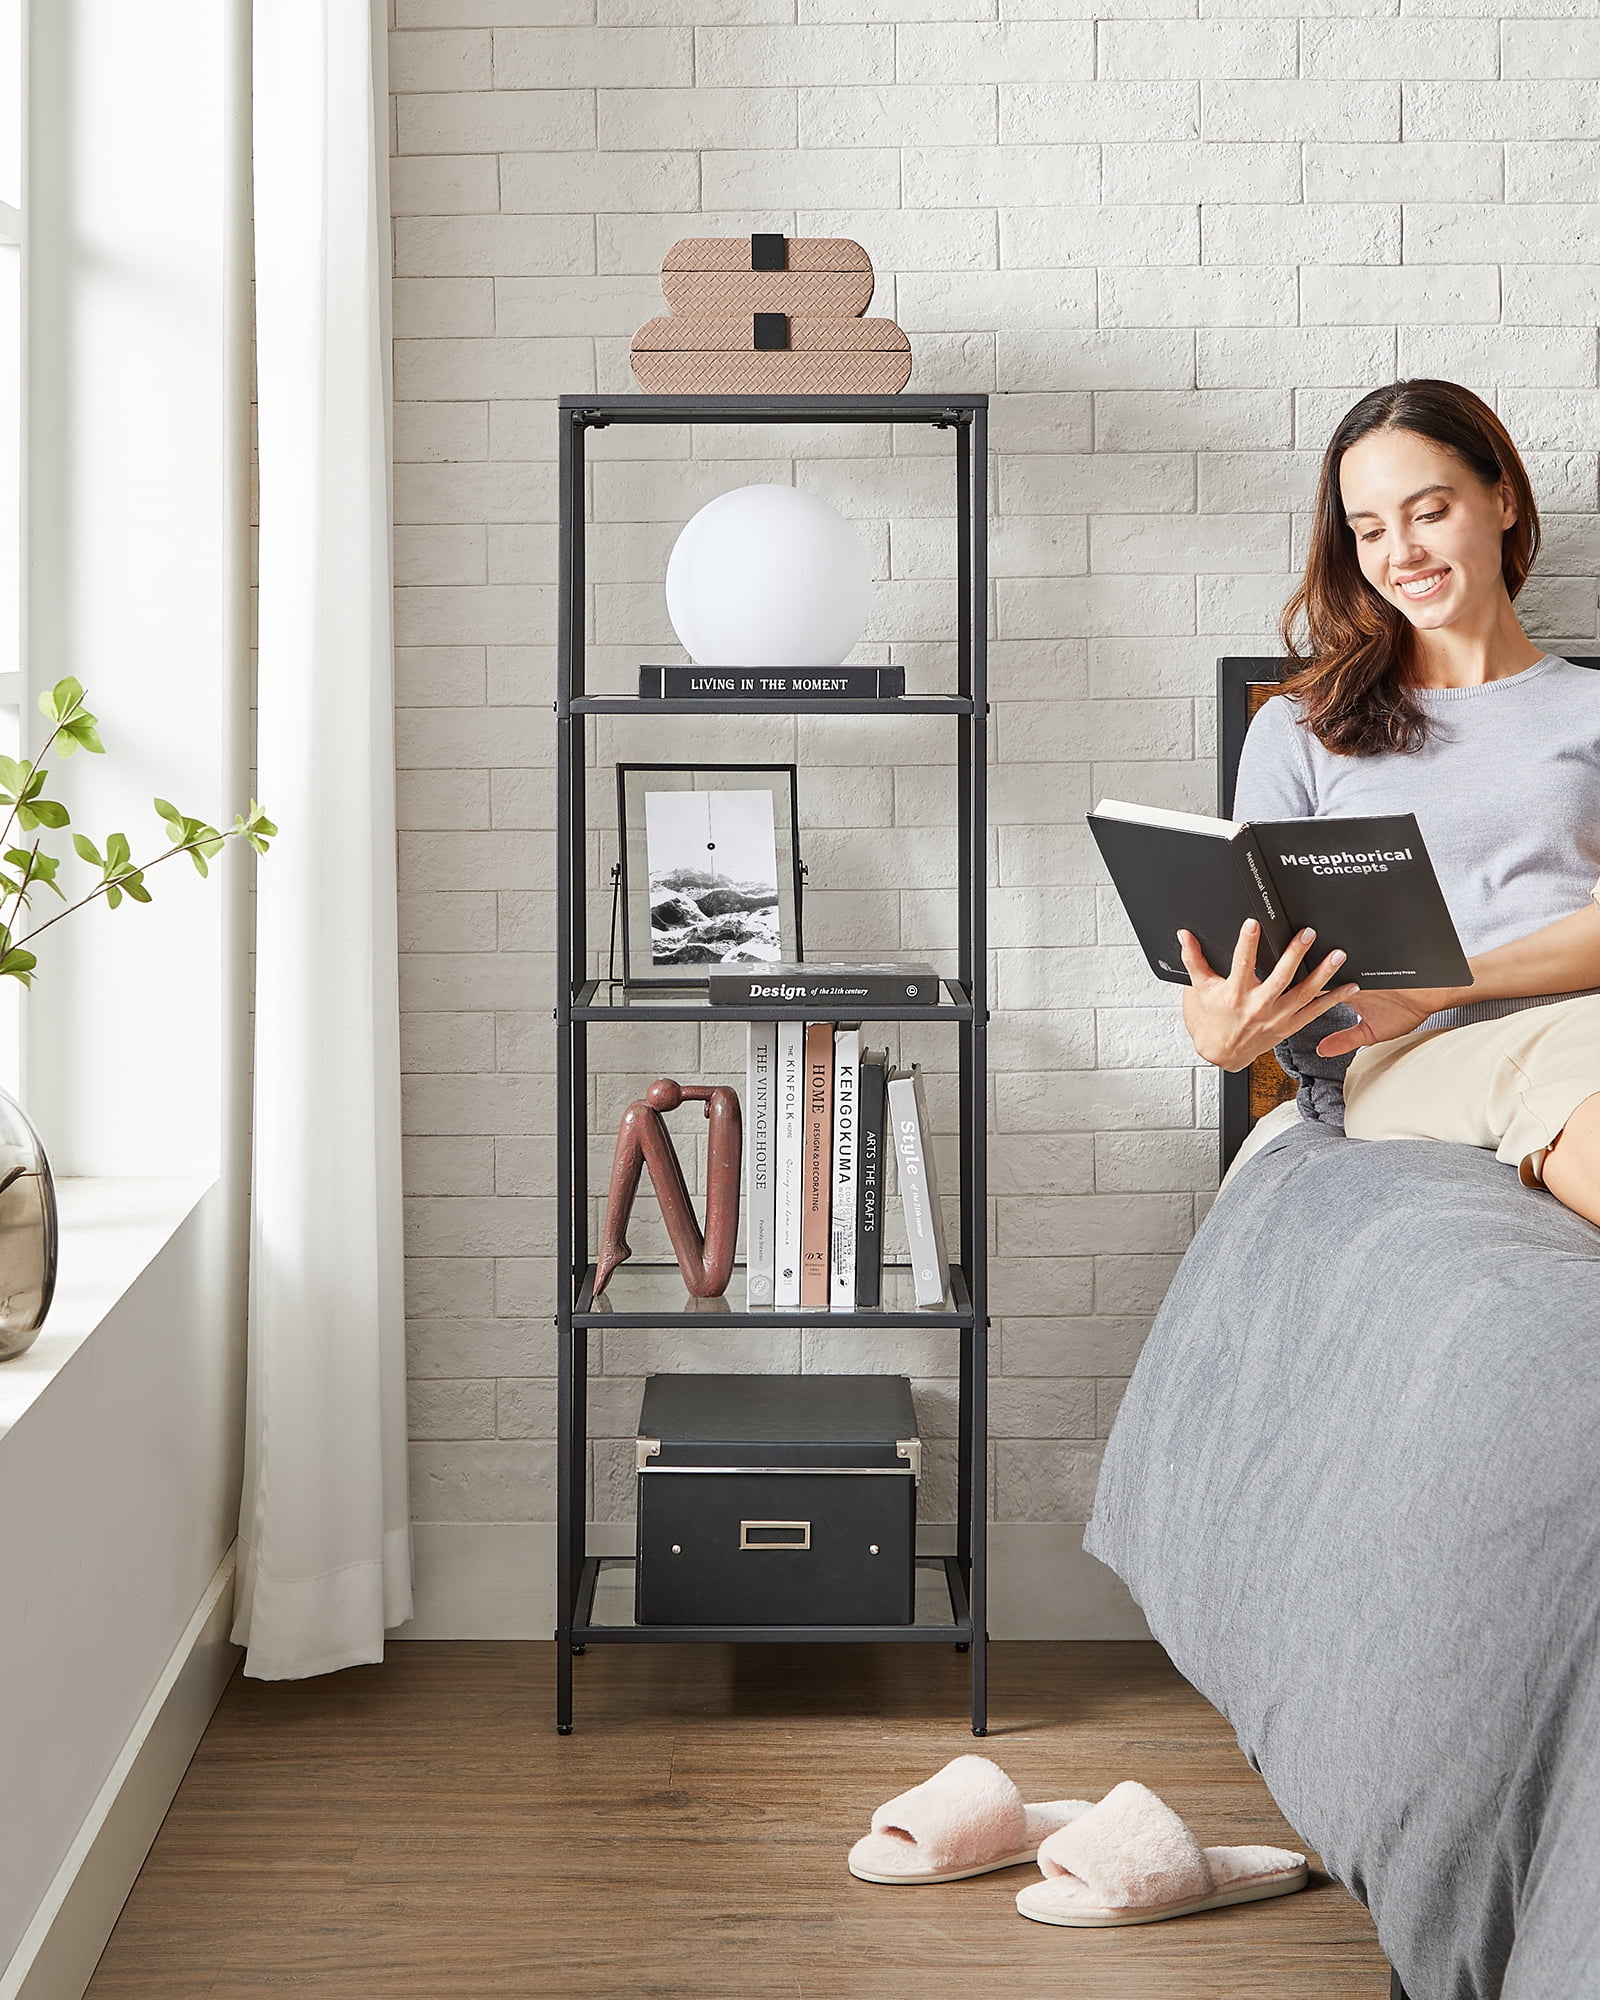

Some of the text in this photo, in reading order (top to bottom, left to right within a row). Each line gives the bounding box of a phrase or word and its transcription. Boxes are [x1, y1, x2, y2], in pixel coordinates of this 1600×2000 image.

[691, 677, 849, 691] LIVING IN THE MOMENT
[1244, 850, 1276, 920] Metaphorical Concepts
[1279, 847, 1413, 867] Metaphorical
[1313, 861, 1389, 876] Concepts
[749, 983, 869, 1000] Design of the 21th century
[756, 1044, 767, 1190] THE VINTAGE HOUSE
[785, 1060, 795, 1120] KINFOLK
[812, 1064, 825, 1212] HOME DESIGN & DECORATING
[900, 1120, 919, 1175] Style
[911, 1183, 919, 1191] of
[864, 1130, 876, 1232] ARTS THE CRAFTS
